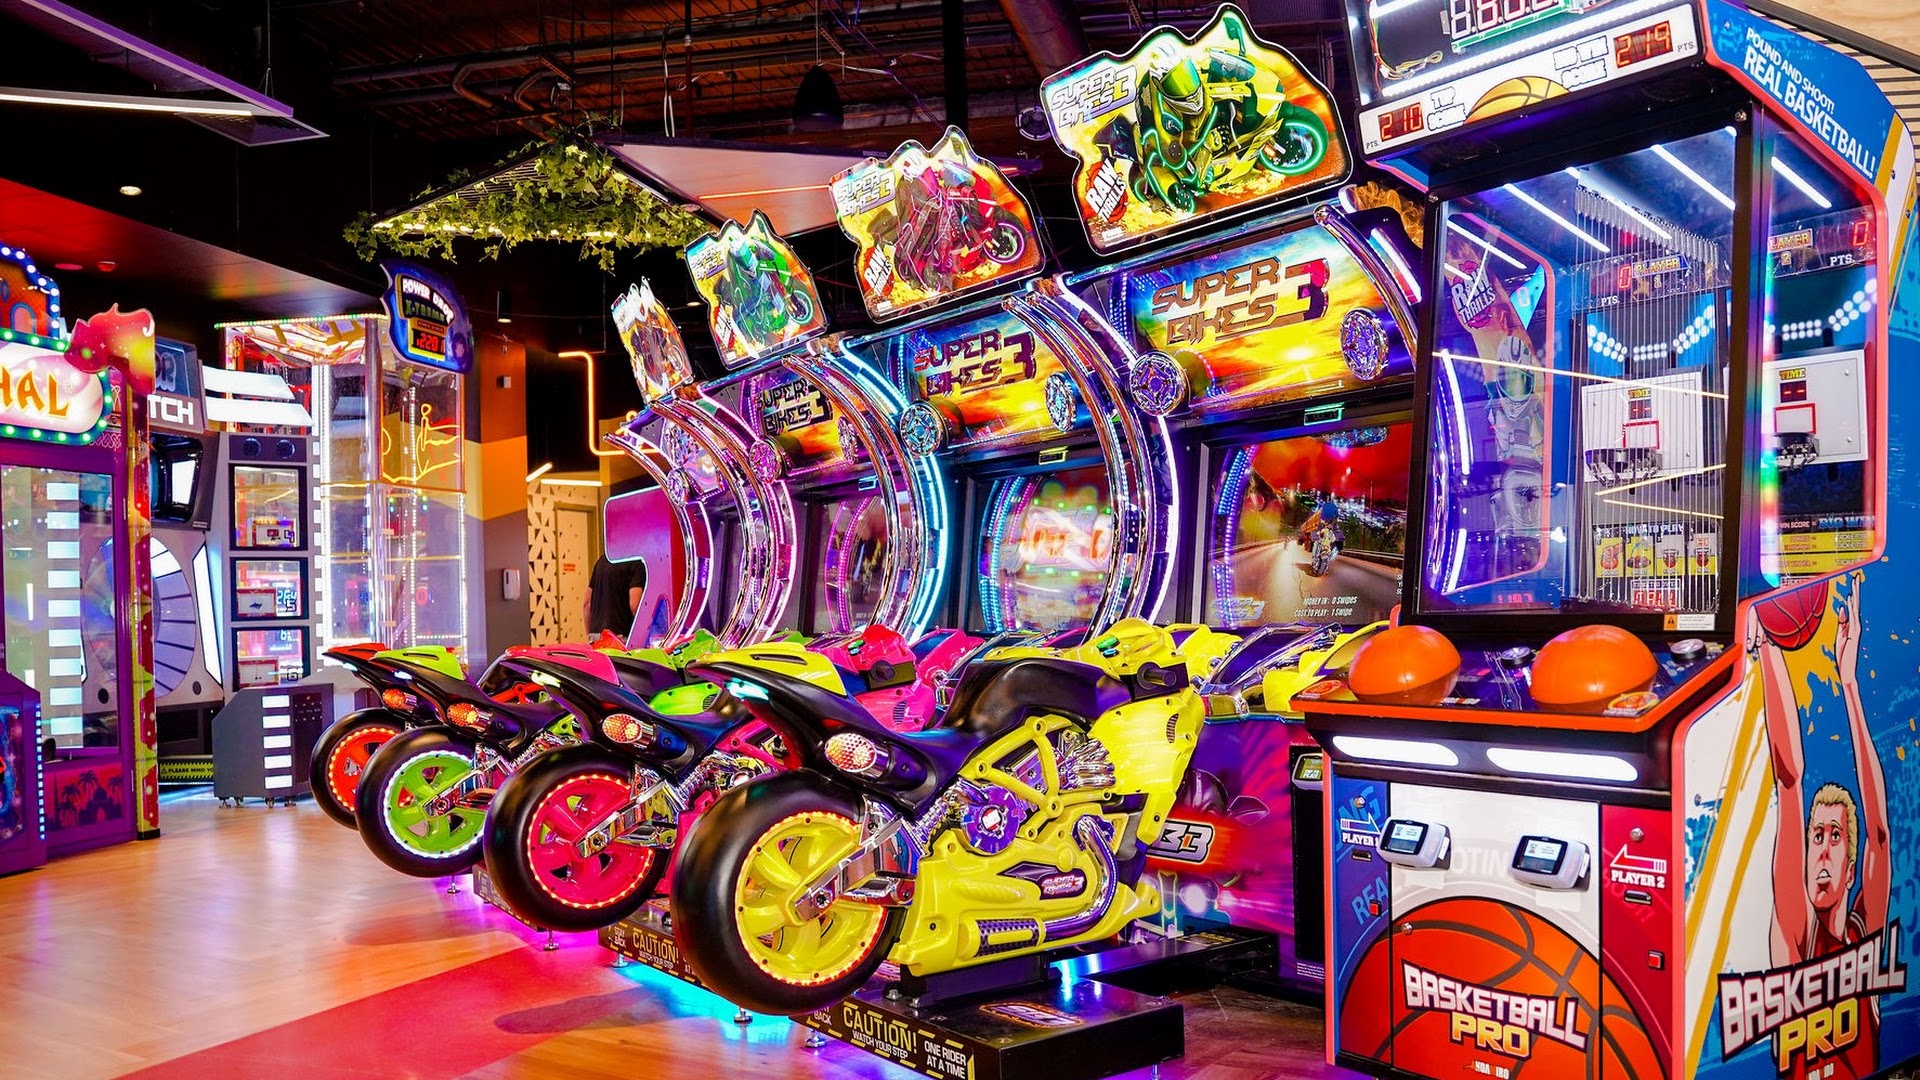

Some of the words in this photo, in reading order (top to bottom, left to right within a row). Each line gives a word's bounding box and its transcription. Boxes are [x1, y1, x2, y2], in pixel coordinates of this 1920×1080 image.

[1050, 66, 1118, 111] SUPER
[1746, 27, 1781, 66] POUND
[1781, 60, 1802, 84] AND
[1802, 78, 1835, 115] SHOOT!
[1744, 46, 1783, 100] REAL
[1783, 81, 1877, 179] BASKETBALL!
[1085, 157, 1120, 212] RAW
[1097, 176, 1128, 223] THRILLS
[1853, 221, 1870, 247] 0
[1635, 258, 1680, 275] PLAYER
[1781, 251, 1792, 266] 2
[1830, 254, 1856, 267] PTS.
[402, 278, 431, 301] POWER
[432, 291, 455, 325] DROP
[1151, 256, 1282, 315] SUPER
[1451, 265, 1490, 312] RAW
[1459, 286, 1496, 325] THRILLS
[1601, 295, 1621, 307] PTS.
[914, 329, 1004, 373] SUPER
[1779, 368, 1807, 380] TIME
[1342, 832, 1374, 846] PLAYER
[1611, 869, 1656, 887] PLAYER
[1656, 875, 1666, 888] 2
[632, 931, 680, 965] CAUTION!
[1402, 963, 1589, 1050] BASKETBALL
[1719, 924, 1905, 1057] BASKETBALL
[813, 1011, 832, 1026] BACK
[843, 1006, 917, 1055] CAUTION!
[1452, 1011, 1531, 1059] PRO
[1778, 997, 1859, 1073] PRO
[852, 1029, 875, 1048] WATCH
[874, 1037, 893, 1055] YOUR
[892, 1046, 909, 1060] STEP
[924, 1040, 942, 1058] ONE
[942, 1046, 967, 1067] RIDER
[926, 1055, 938, 1068] AT
[938, 1059, 946, 1071] A
[945, 1060, 966, 1079] TIME
